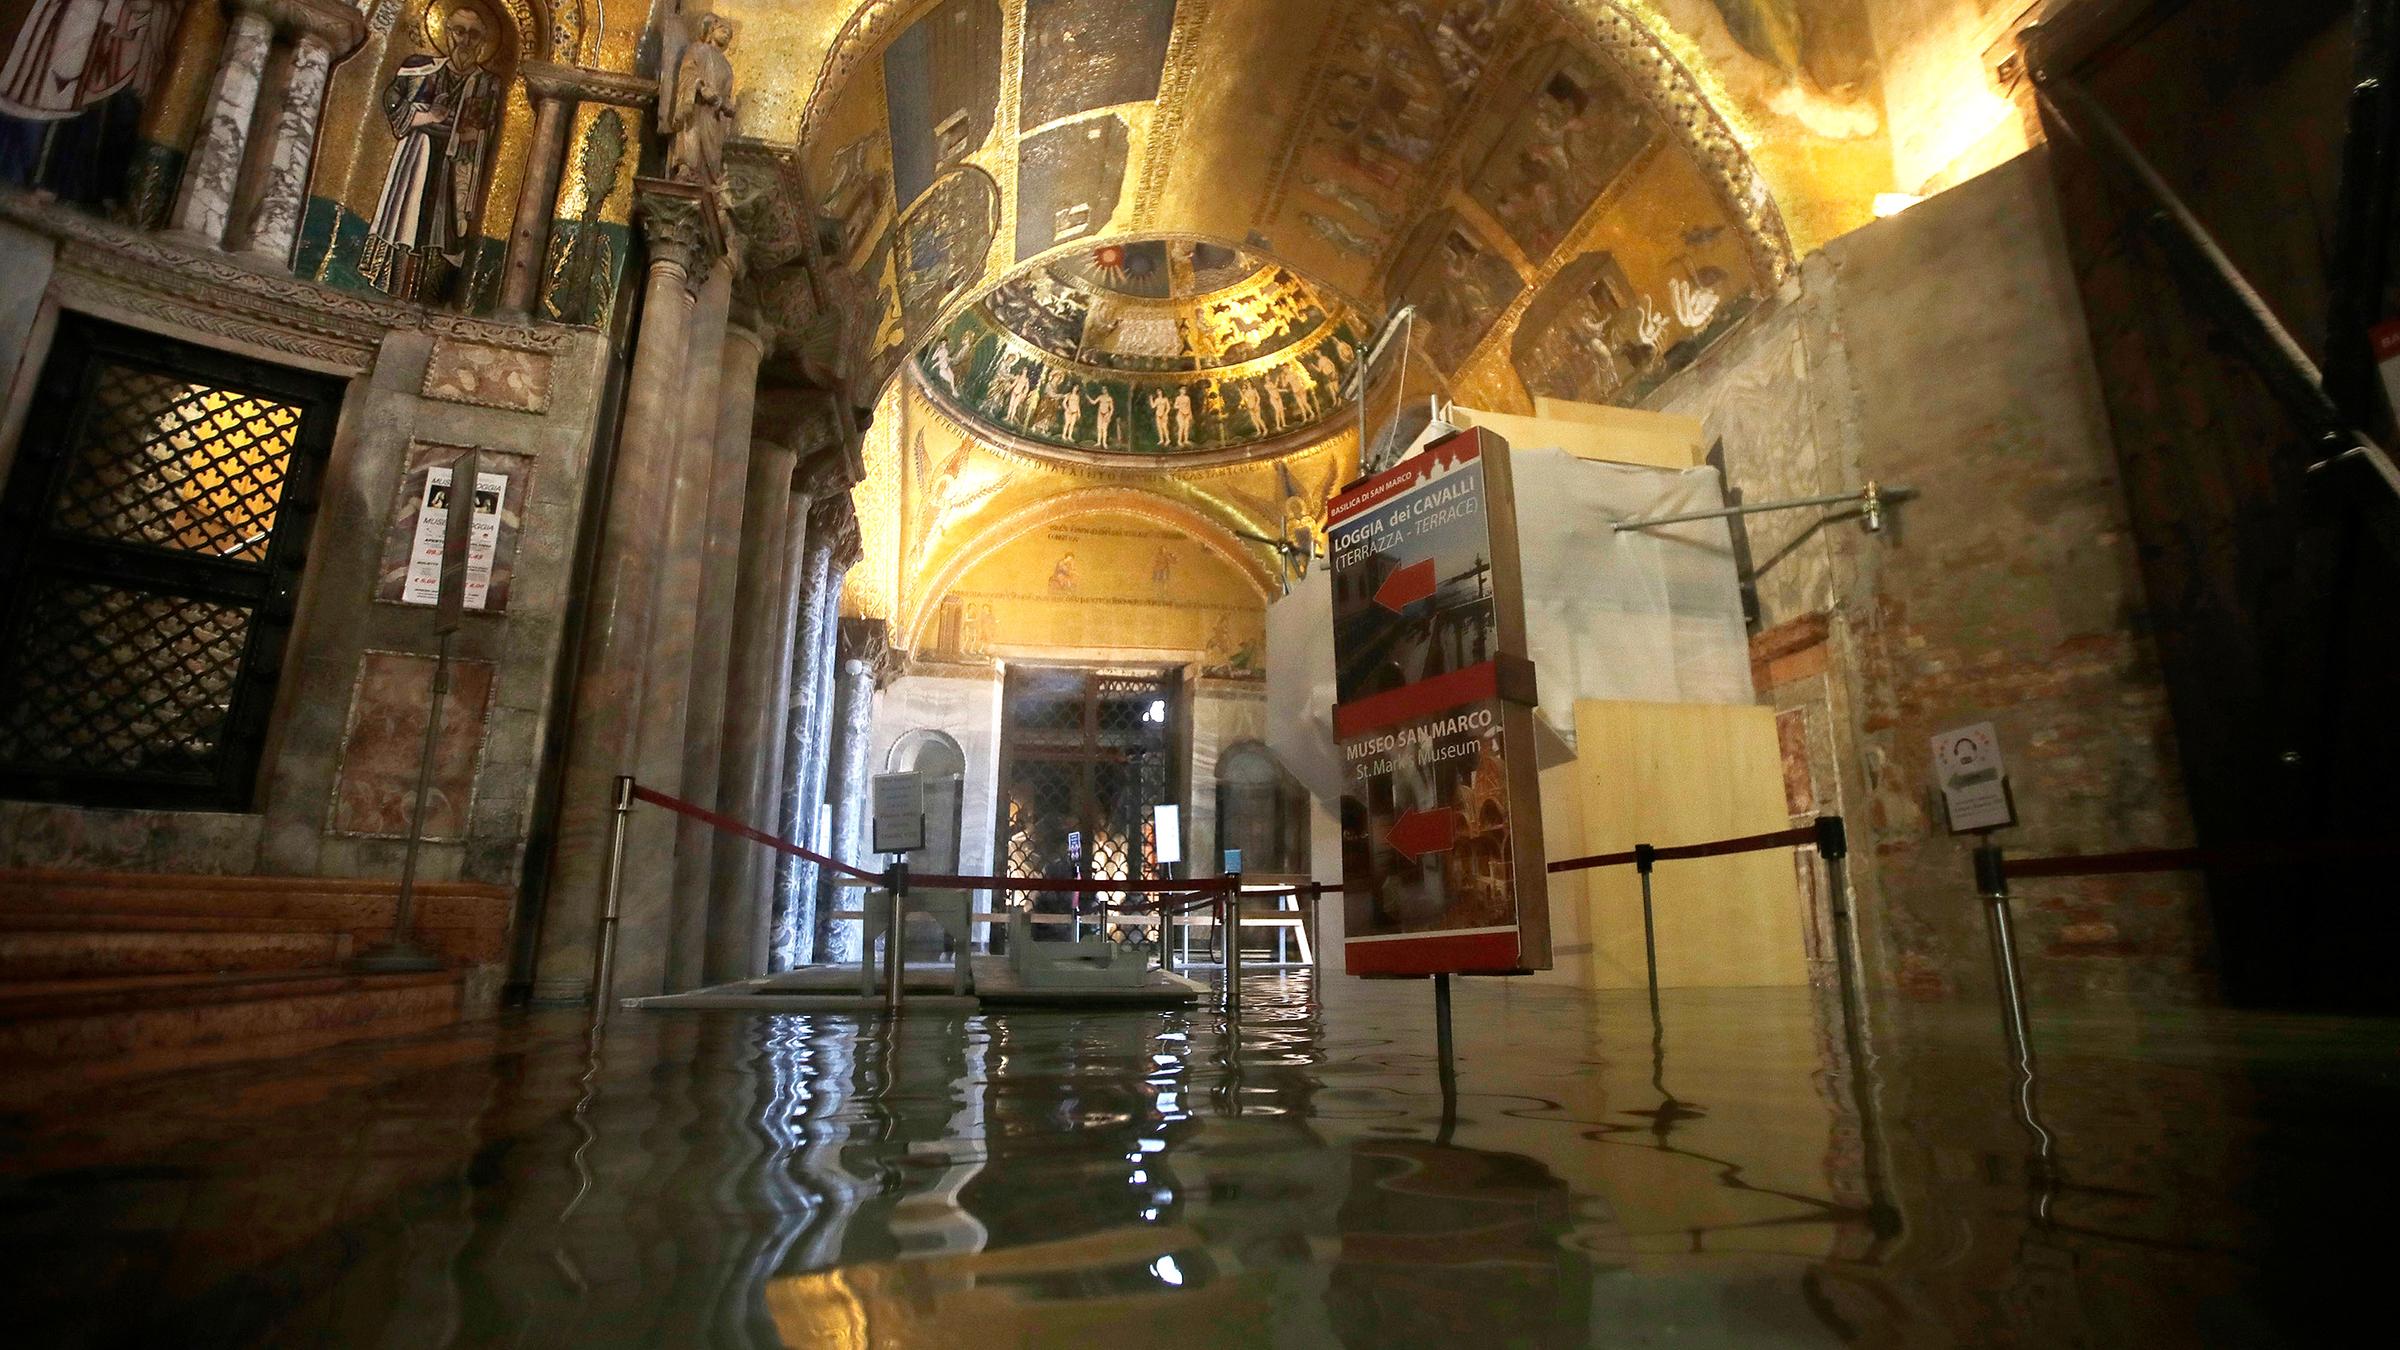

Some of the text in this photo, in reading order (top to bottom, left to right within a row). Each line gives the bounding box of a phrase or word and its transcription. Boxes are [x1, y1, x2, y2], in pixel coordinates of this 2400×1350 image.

[1331, 471, 1412, 517] BASILICA DI SAN MARCO
[1335, 476, 1475, 553] LOGGIA dei CAVALLI
[1335, 532, 1404, 573] (TERRAZZA
[1414, 496, 1479, 536] TERRACE)
[1346, 709, 1492, 761] MUSEO SAN MARCO
[1356, 763, 1373, 780] St.
[1418, 738, 1481, 766] Museum
